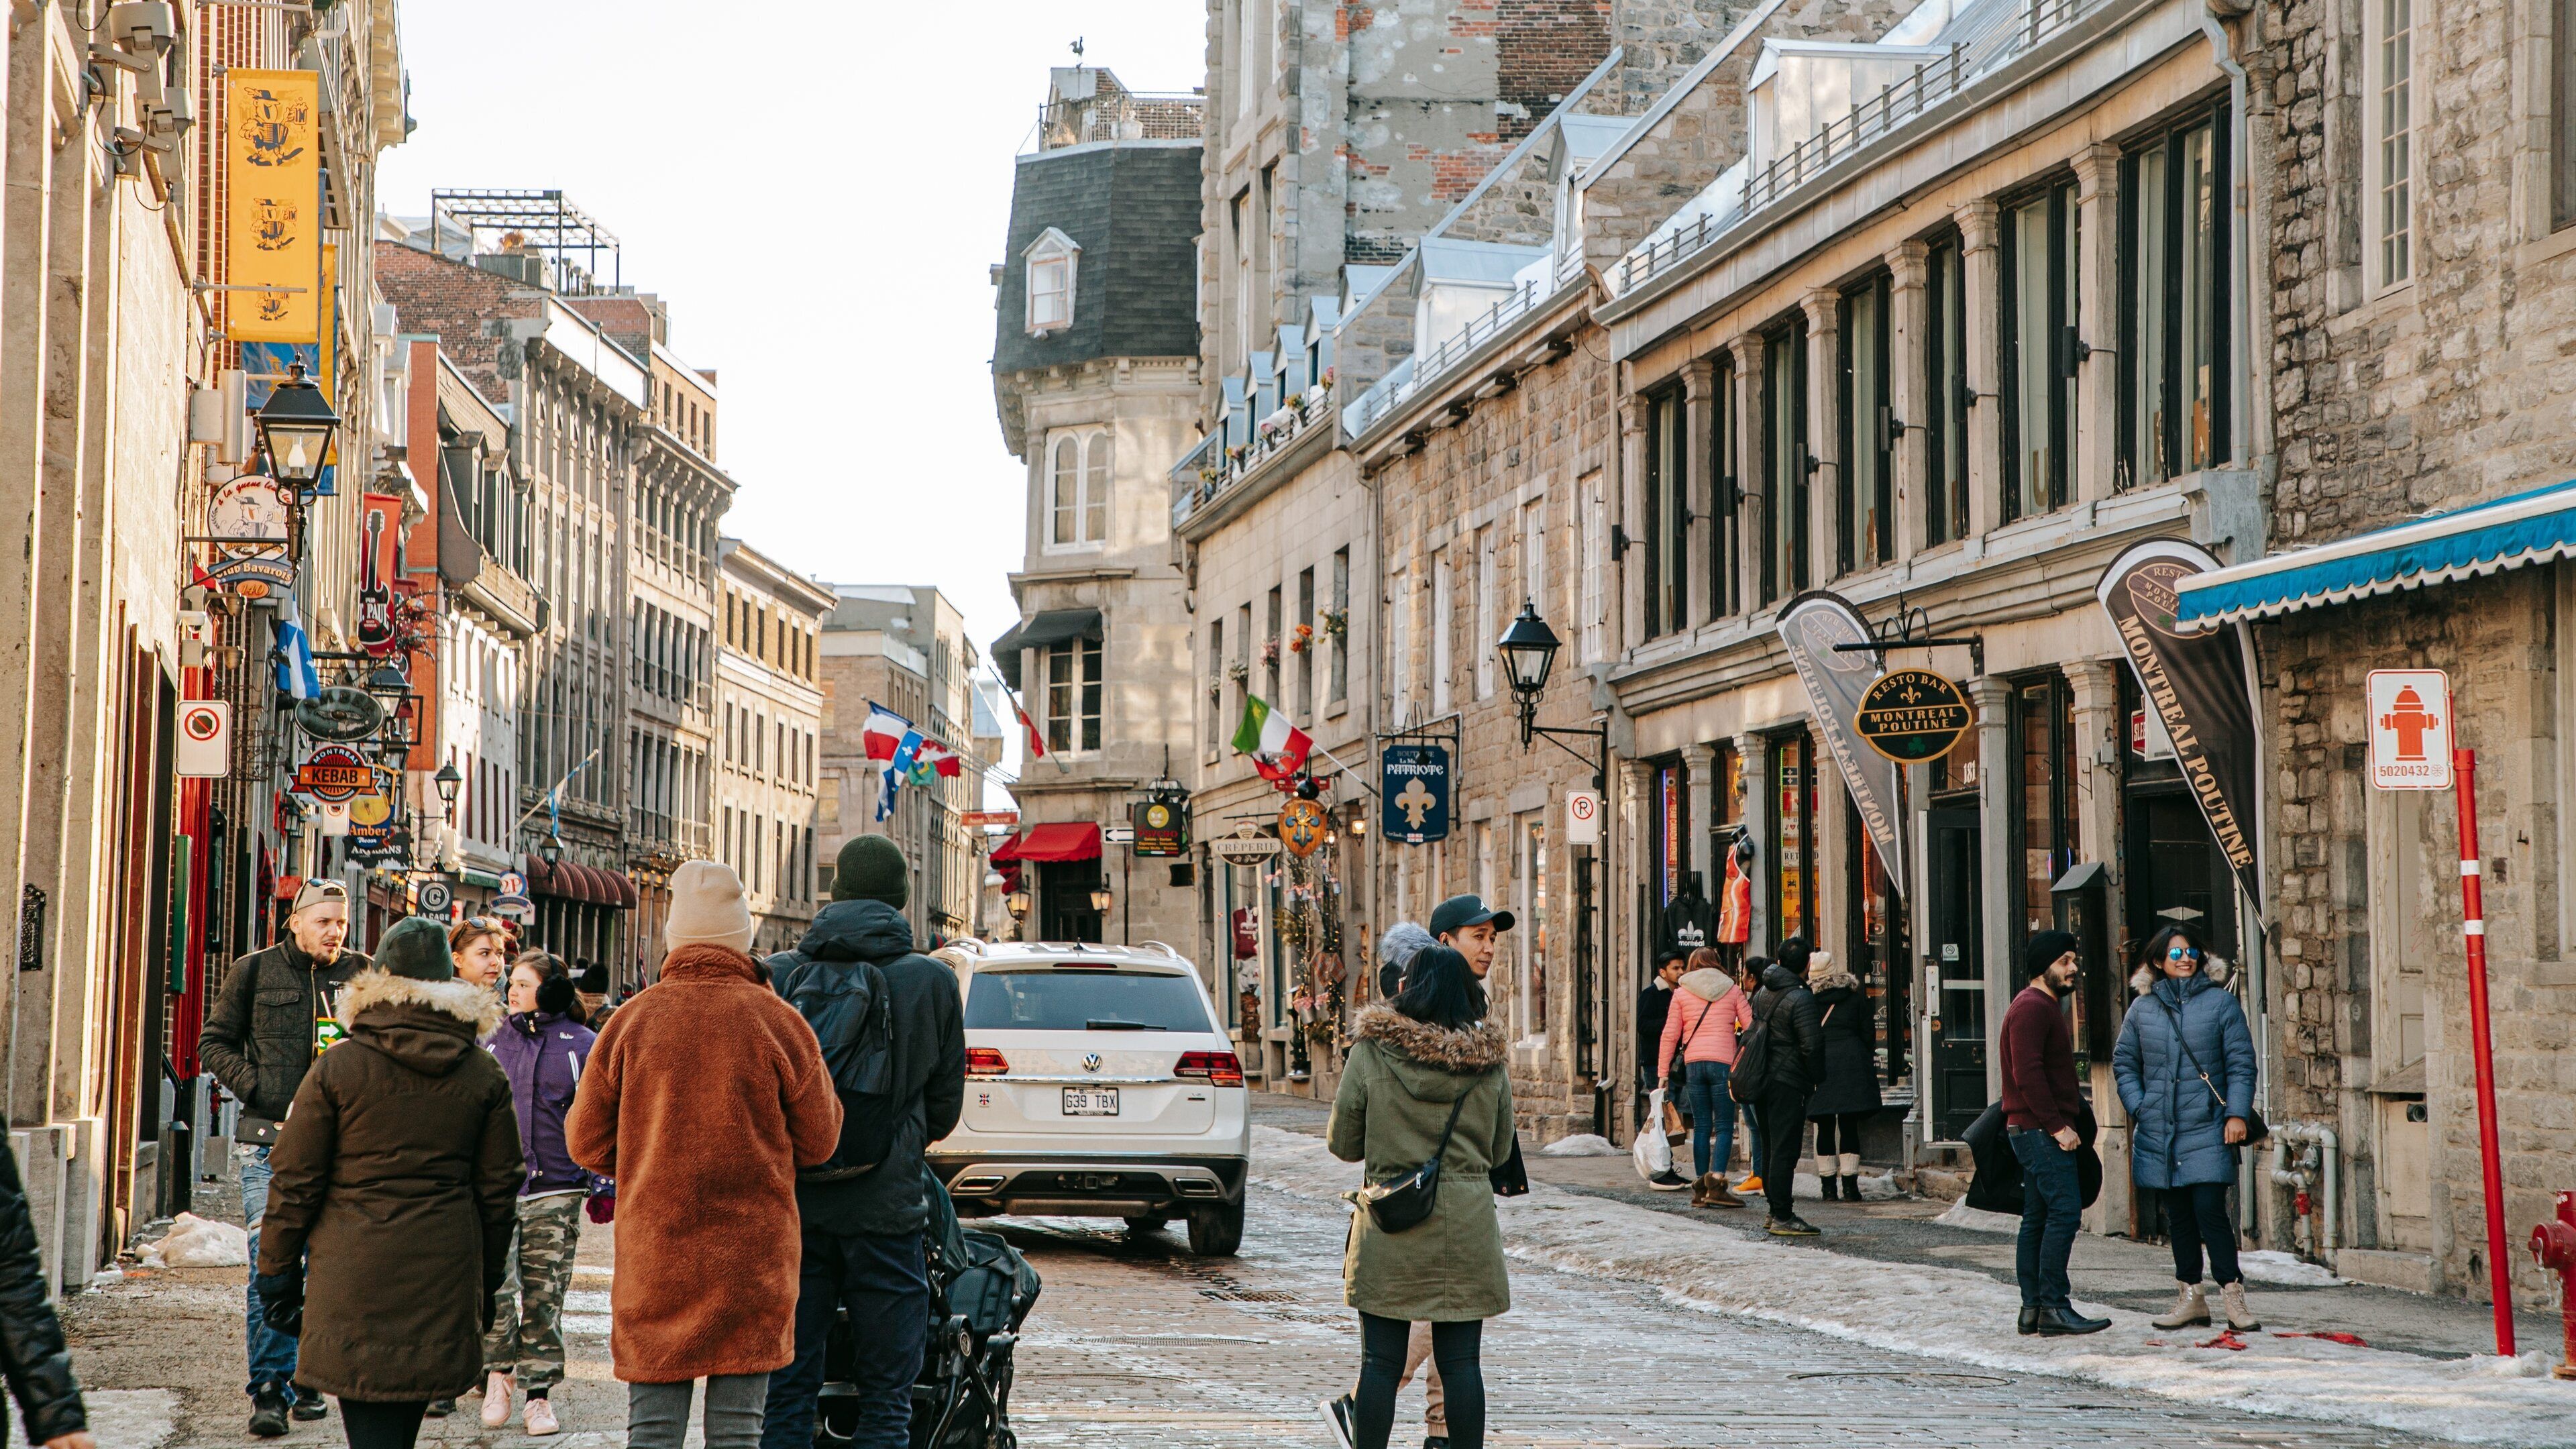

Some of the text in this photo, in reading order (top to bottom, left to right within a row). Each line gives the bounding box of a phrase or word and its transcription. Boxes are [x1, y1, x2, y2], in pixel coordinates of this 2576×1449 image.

[215, 562, 292, 581] Club Bavarois
[241, 584, 265, 596] 140
[2145, 582, 2179, 606] MONT
[2147, 591, 2177, 611] POUT
[367, 603, 389, 631] PAUL
[1872, 674, 1947, 701] RESTO BAR
[1871, 708, 1957, 723] MONTREAL
[1880, 718, 1950, 733] POUTINE
[2118, 614, 2253, 869] MONTREAL POUTINE
[313, 748, 360, 765] MONTREAL
[312, 768, 358, 784] KEBAB
[1387, 764, 1444, 775] PATRIOTE
[1964, 759, 1976, 785] 181
[2380, 766, 2429, 776] 5020432
[349, 824, 387, 836] Amber
[1218, 841, 1277, 852] CRÊPERIE
[429, 913, 450, 921] CAGE
[1066, 1095, 1116, 1108] G39 TBX
